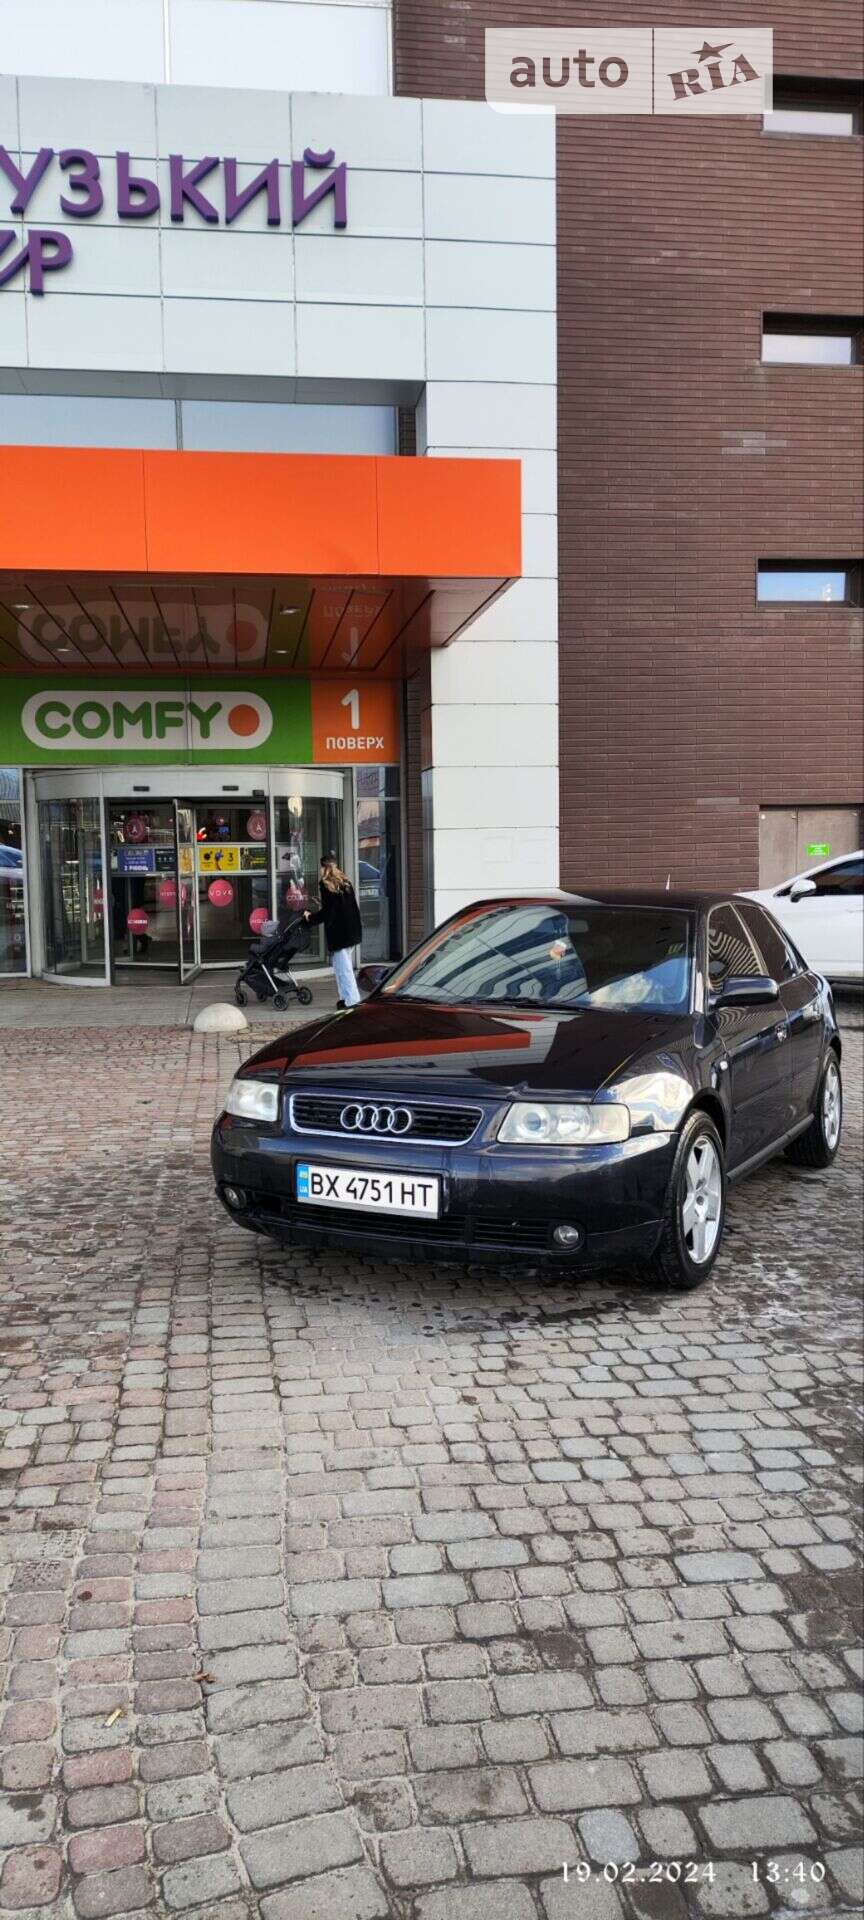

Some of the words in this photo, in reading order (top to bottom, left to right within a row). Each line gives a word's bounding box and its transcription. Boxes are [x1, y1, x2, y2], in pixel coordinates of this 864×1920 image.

[34, 700, 222, 740] COMFY
[341, 688, 360, 730] 1
[326, 736, 385, 750] ПОВЕРХ
[311, 1173, 339, 1198] BX
[346, 1177, 393, 1203] 4751
[401, 1182, 433, 1206] HT
